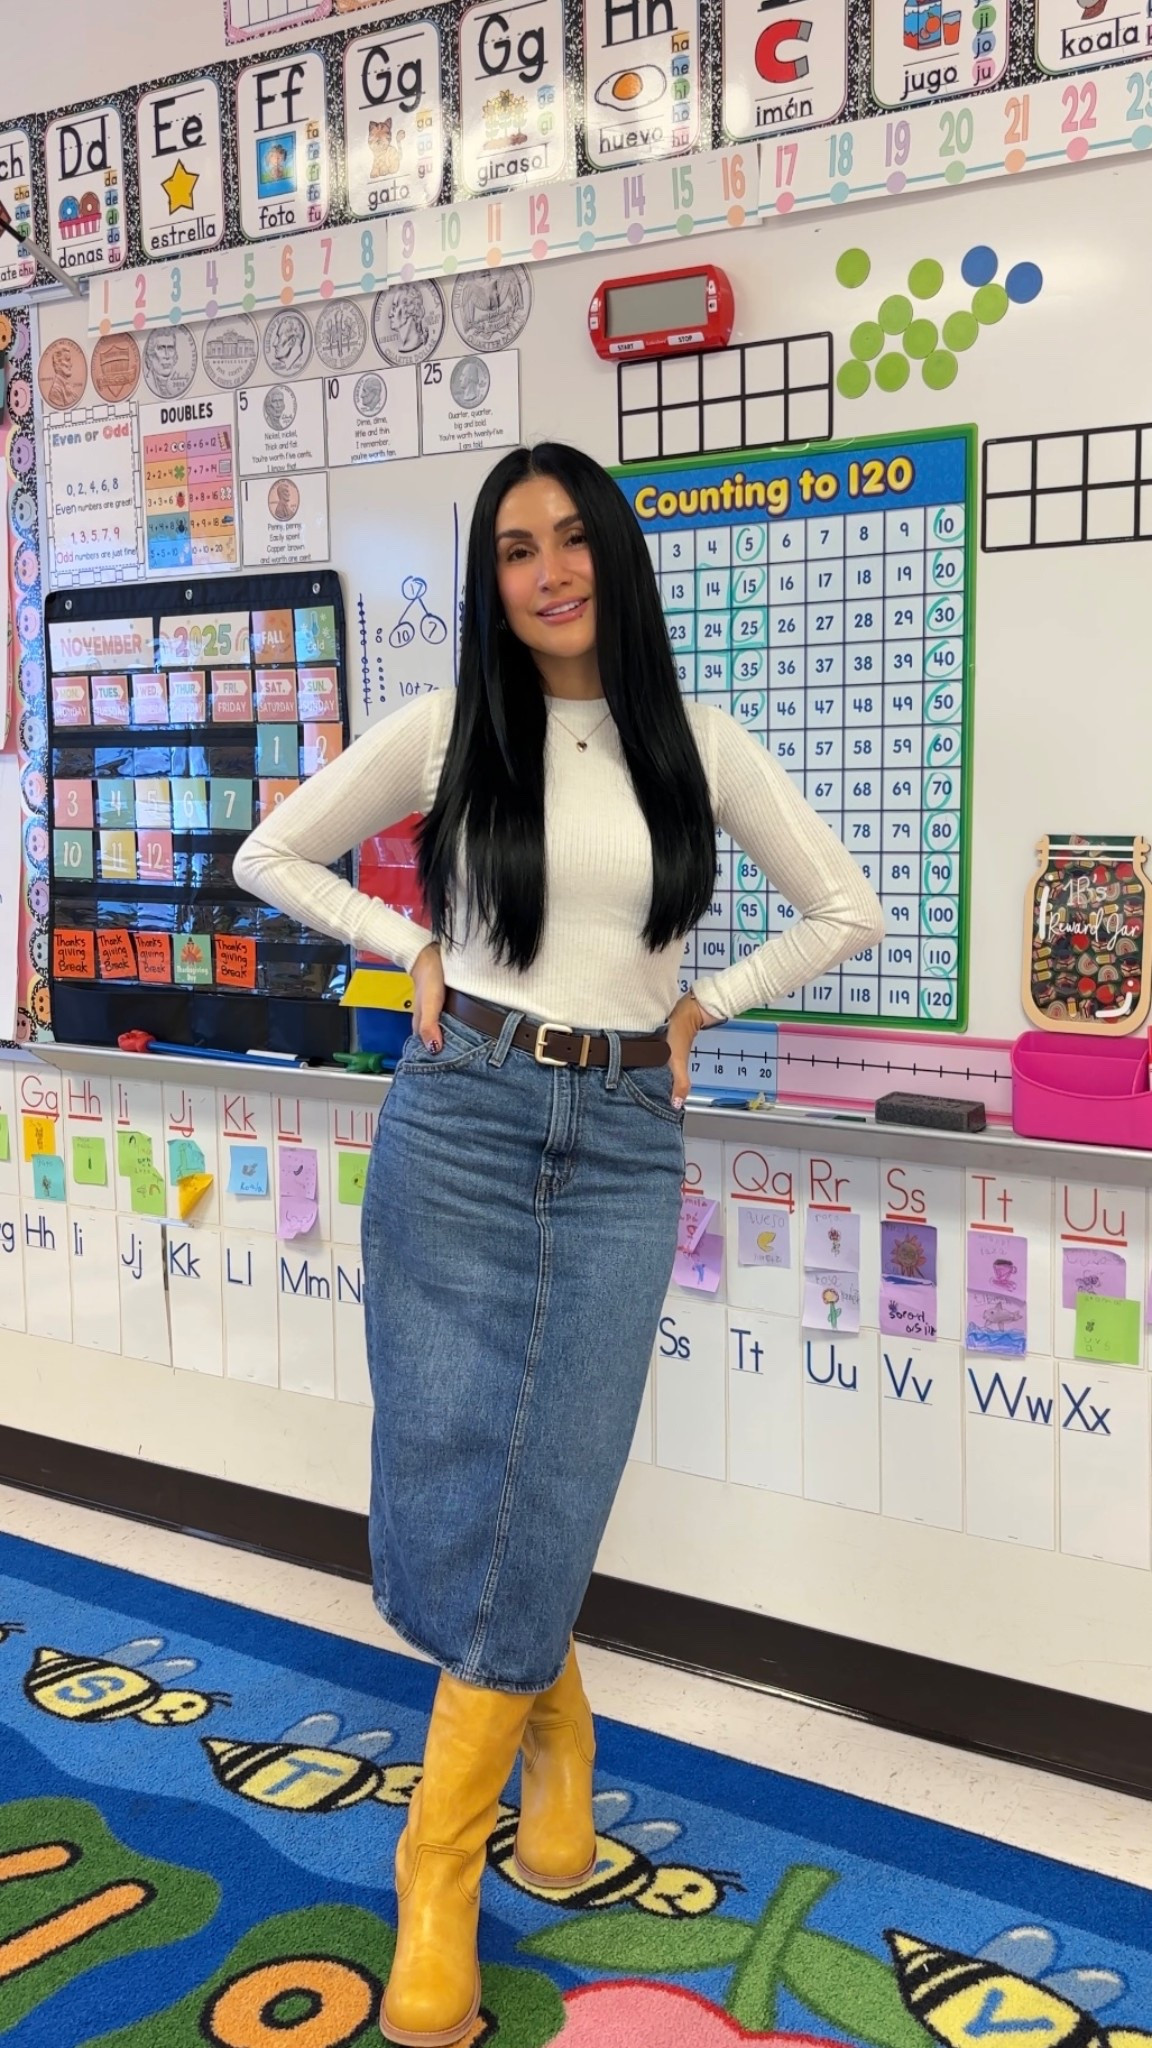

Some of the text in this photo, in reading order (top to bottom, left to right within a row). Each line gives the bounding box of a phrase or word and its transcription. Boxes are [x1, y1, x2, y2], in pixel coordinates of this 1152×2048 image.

[479, 13, 543, 83] Gg
[672, 35, 690, 52] ha
[1061, 18, 1139, 59] koala
[362, 46, 422, 112] Gg
[900, 66, 958, 100] jugo
[974, 64, 992, 86] ju
[256, 64, 304, 131] Ff
[756, 97, 813, 127] imán
[153, 99, 203, 155] Ee
[600, 127, 664, 154] huevo
[775, 81, 1098, 188] 17 18 19 20 21 22
[60, 115, 110, 179] Dd
[477, 143, 548, 187] girasol
[368, 180, 410, 211] gato
[401, 154, 746, 259] 9 10 11 12 13 14 15 16
[151, 216, 216, 249] estrella
[259, 206, 296, 229] foto
[58, 246, 104, 269] donas
[103, 230, 374, 314] 1 2 3 4 5 6 7 8
[617, 343, 634, 351] START
[678, 335, 692, 343] STOP
[328, 378, 340, 400] 10
[424, 363, 442, 385] 25
[161, 402, 213, 424] DOUBLES
[239, 391, 248, 411] 5
[52, 432, 81, 447] Even
[84, 430, 99, 442] or
[112, 477, 119, 490] 8
[634, 456, 914, 519] Counting to 120
[55, 503, 77, 516] Even
[113, 526, 120, 540] 9
[673, 517, 954, 558] 3 4 5 6 7 8 9 10
[672, 561, 955, 599] 13 14 15 16 17 18 19 20
[60, 633, 143, 658] NOVEMBER
[174, 623, 232, 658] 2025
[261, 629, 285, 645] FALL
[396, 629, 410, 645] 10
[265, 681, 286, 693] SAT.
[217, 701, 247, 713] FRIDAY
[258, 701, 294, 713] SATURDAY
[274, 735, 280, 765] 1
[67, 790, 78, 817] 3
[183, 789, 194, 817] 6
[223, 789, 236, 818] 7
[815, 780, 952, 797] 67 68 69 70
[63, 841, 82, 868] 10
[740, 902, 953, 924] 95 96 99 100
[1049, 907, 1140, 951] Reward Jar
[54, 934, 86, 948] Thanks
[58, 948, 86, 960] giving
[58, 961, 88, 973] Break
[813, 986, 952, 1008] 117 118 119 120
[714, 1064, 772, 1079] 18 19 20
[21, 1075, 58, 1122] Gg
[68, 1079, 102, 1114] Hh
[169, 1089, 194, 1137] Jj
[223, 1094, 256, 1132] Kk
[733, 1150, 795, 1214] Qq
[810, 1158, 851, 1203] Rr
[887, 1168, 926, 1214] Ss
[971, 1175, 1013, 1223] Tt
[1063, 1185, 1126, 1237] Uu
[25, 1213, 56, 1249] Hh
[121, 1233, 143, 1280] Jj
[169, 1240, 200, 1278] Kk
[280, 1256, 330, 1299] Mm
[659, 1316, 691, 1359] Ss
[730, 1328, 764, 1372] Tt
[807, 1340, 858, 1390] Uu
[884, 1353, 933, 1403] Vv
[967, 1367, 1054, 1424] Ww
[1062, 1382, 1112, 1435] Xx
[54, 1673, 126, 1705] S
[260, 1757, 343, 1797] T
[965, 1988, 1055, 2038] V
